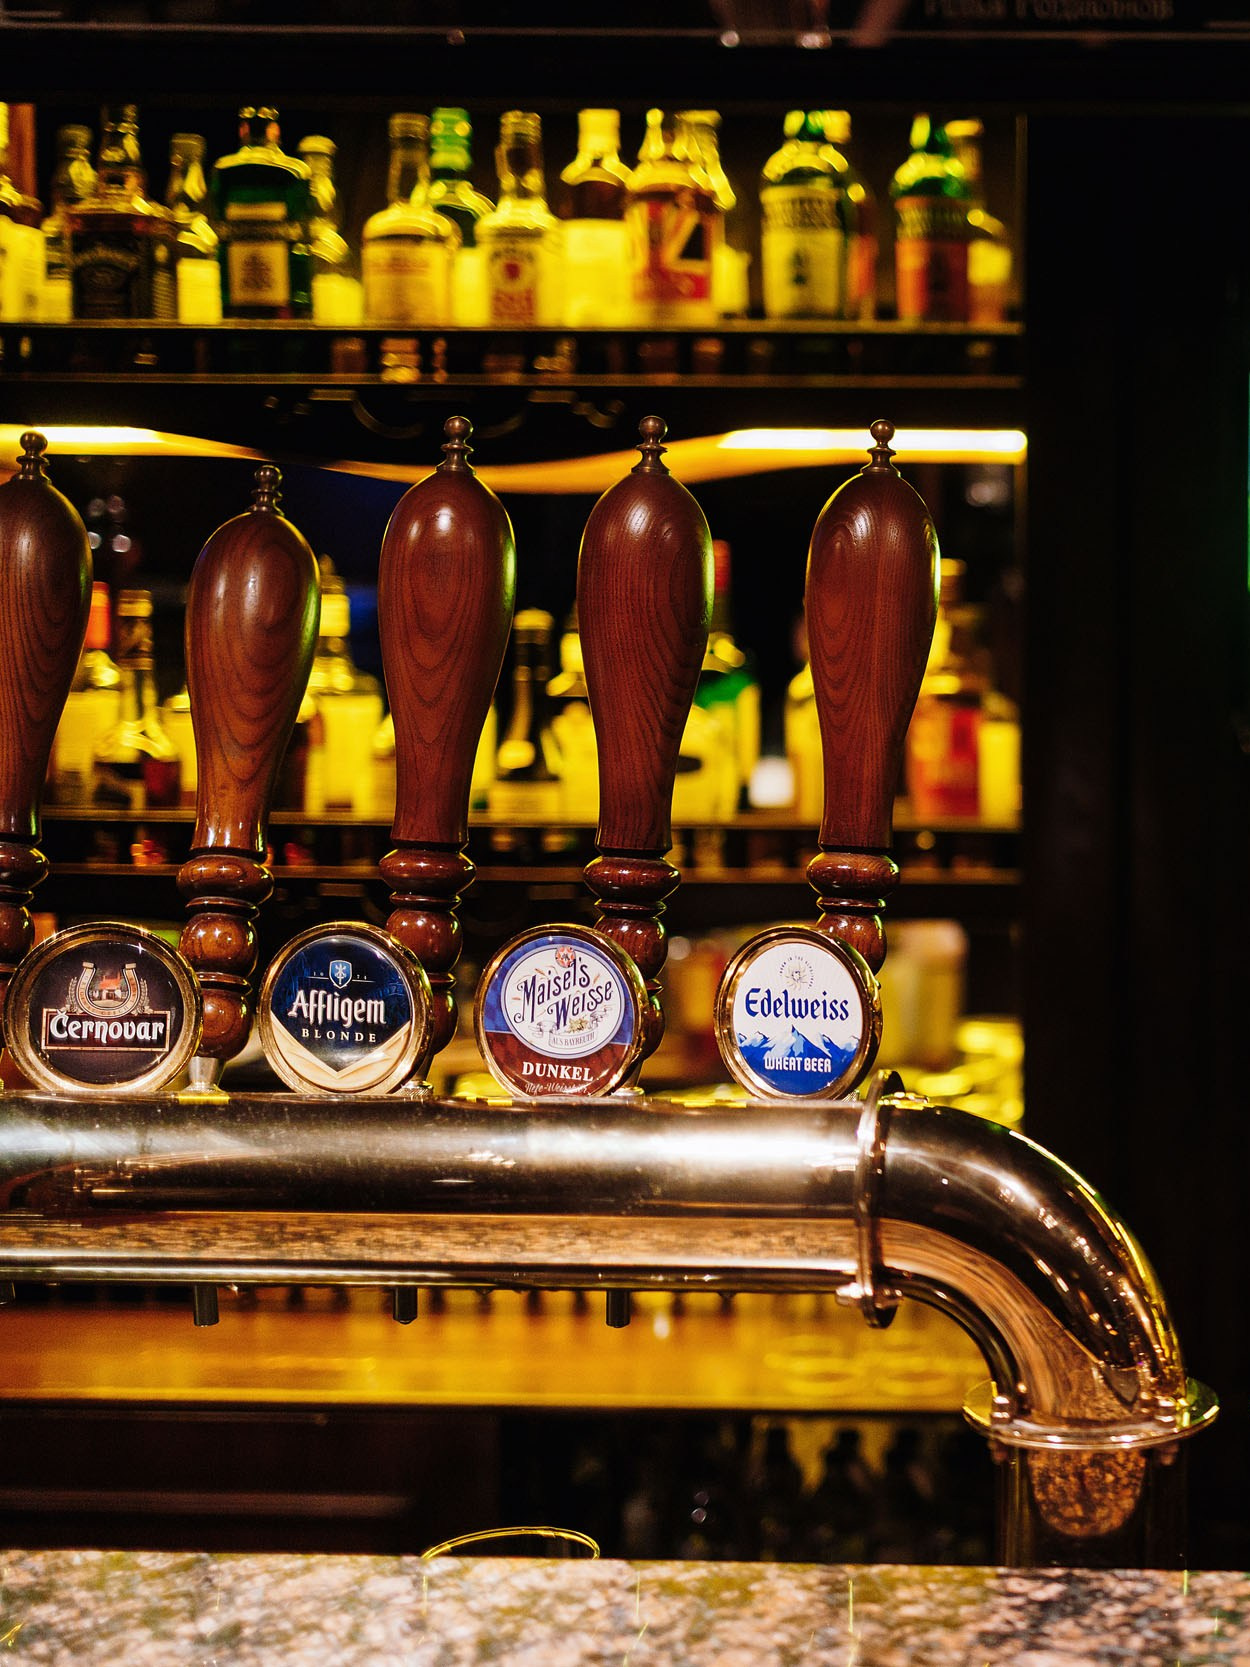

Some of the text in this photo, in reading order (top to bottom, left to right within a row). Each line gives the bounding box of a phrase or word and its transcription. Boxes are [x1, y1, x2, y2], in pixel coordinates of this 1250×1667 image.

[513, 957, 591, 1023] Maisel's
[546, 980, 614, 1030] Weisse
[745, 988, 850, 1021] Edelweiss
[287, 989, 387, 1028] Affligem
[49, 1009, 165, 1044] Černovar
[301, 1028, 377, 1043] BLONDE
[521, 1061, 594, 1082] DUNKEL
[764, 1056, 832, 1073] WHEAT BEER
